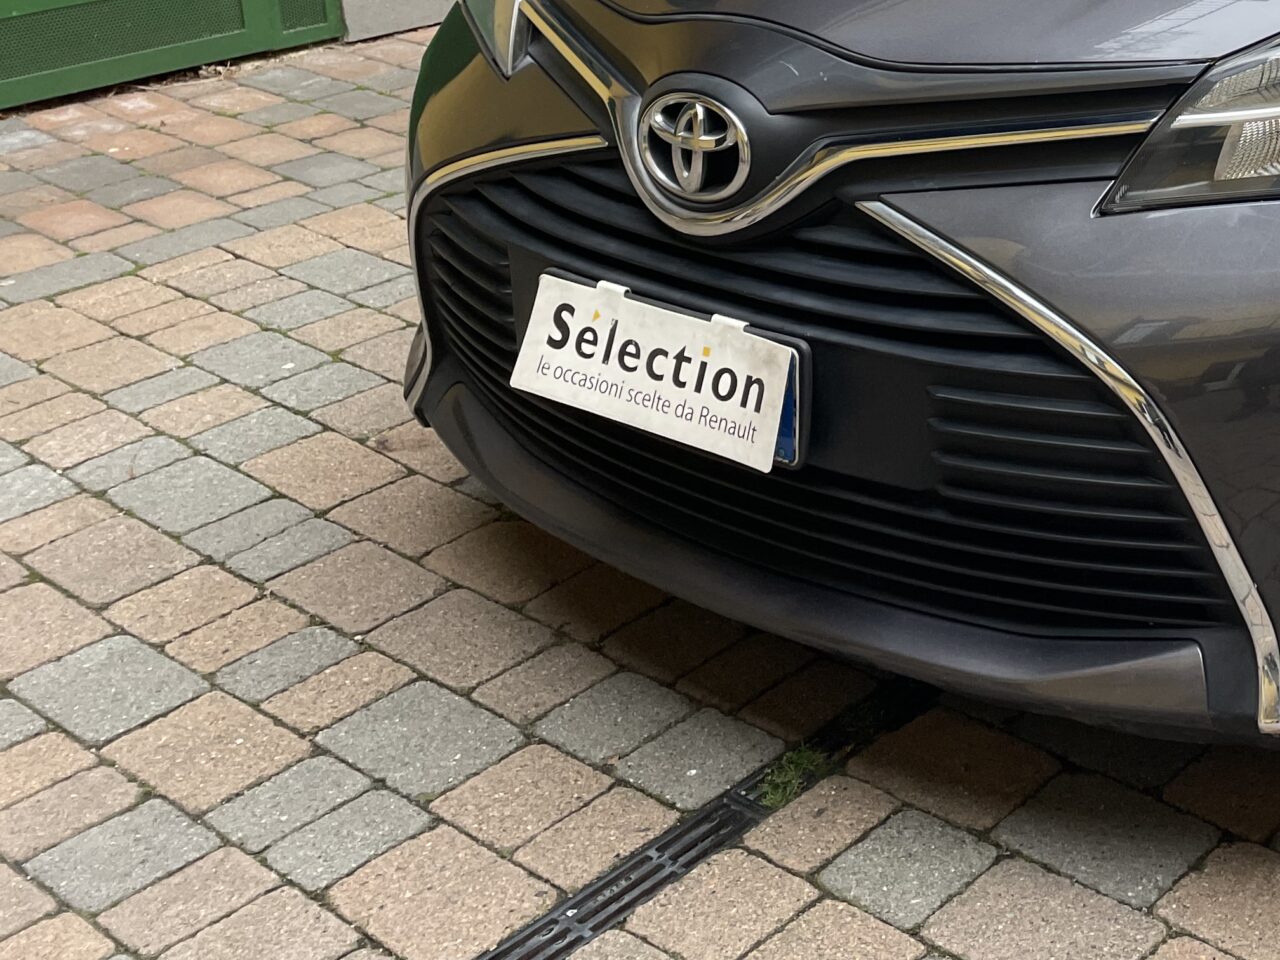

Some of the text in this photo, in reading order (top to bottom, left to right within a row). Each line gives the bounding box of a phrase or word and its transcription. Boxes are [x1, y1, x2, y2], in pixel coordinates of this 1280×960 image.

[536, 354, 757, 444] le occasioni scelte da Renault
